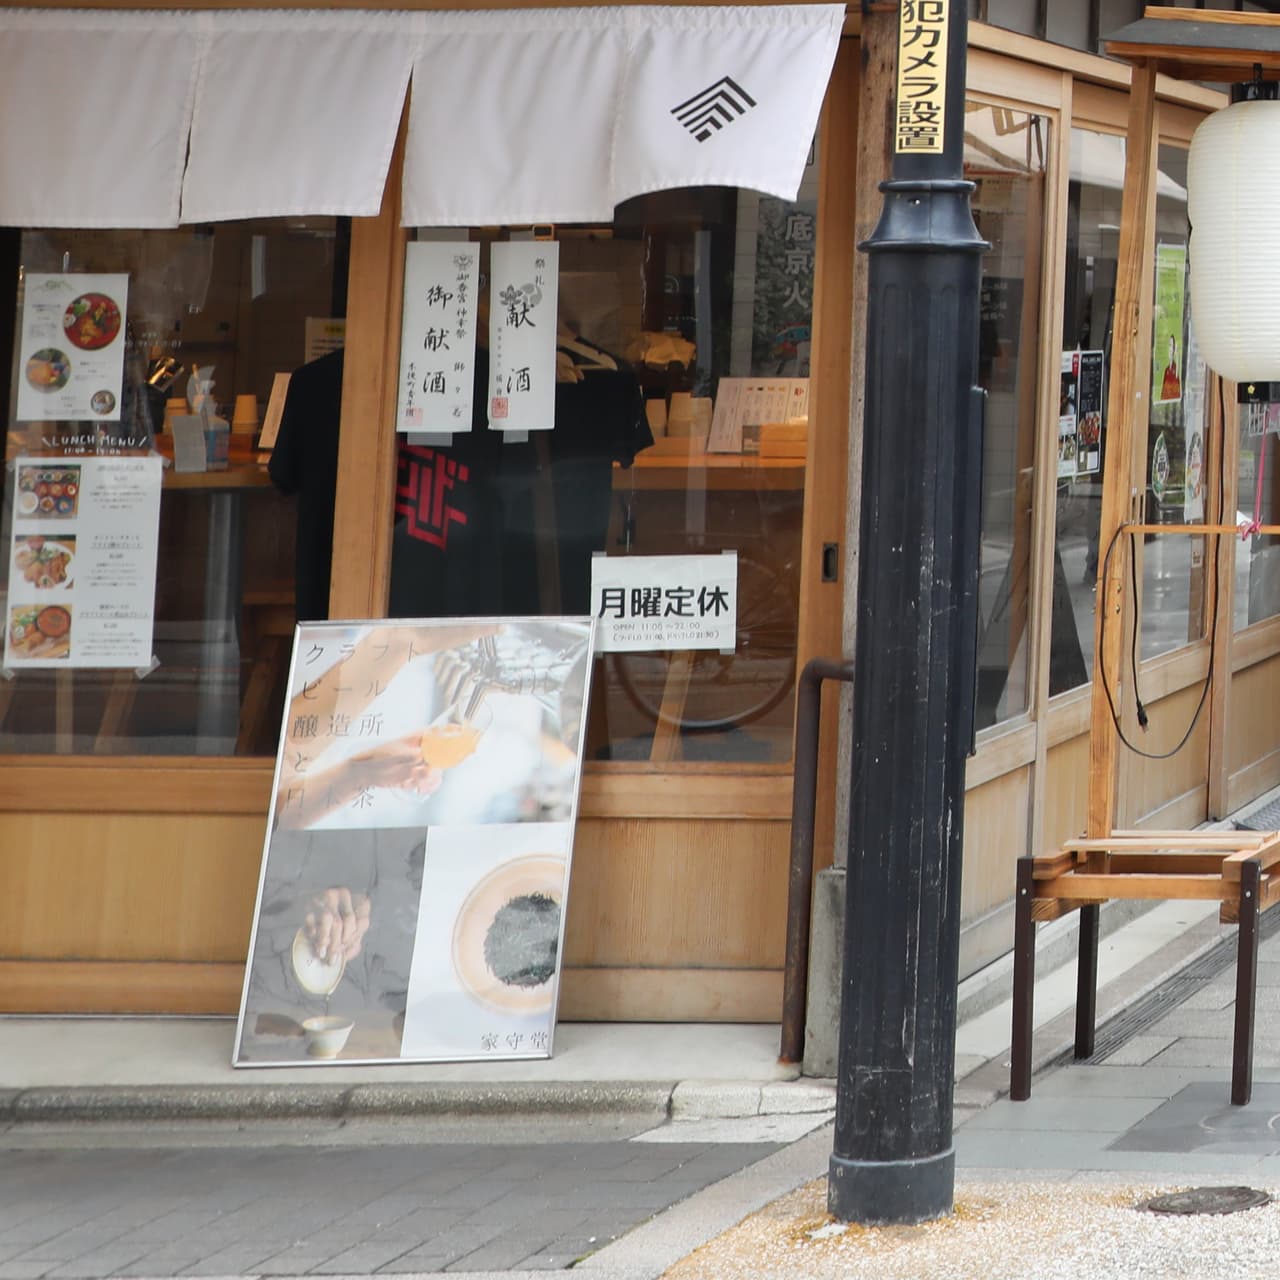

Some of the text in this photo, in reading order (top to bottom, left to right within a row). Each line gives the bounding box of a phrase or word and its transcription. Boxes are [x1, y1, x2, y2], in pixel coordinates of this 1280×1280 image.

[423, 284, 453, 395] 御献酒
[506, 302, 536, 395] 献酒
[52, 435, 135, 446] LUNCH MENU
[598, 586, 729, 618] 月曜定休
[304, 642, 421, 665] クラフト
[292, 714, 384, 738] 醸造所
